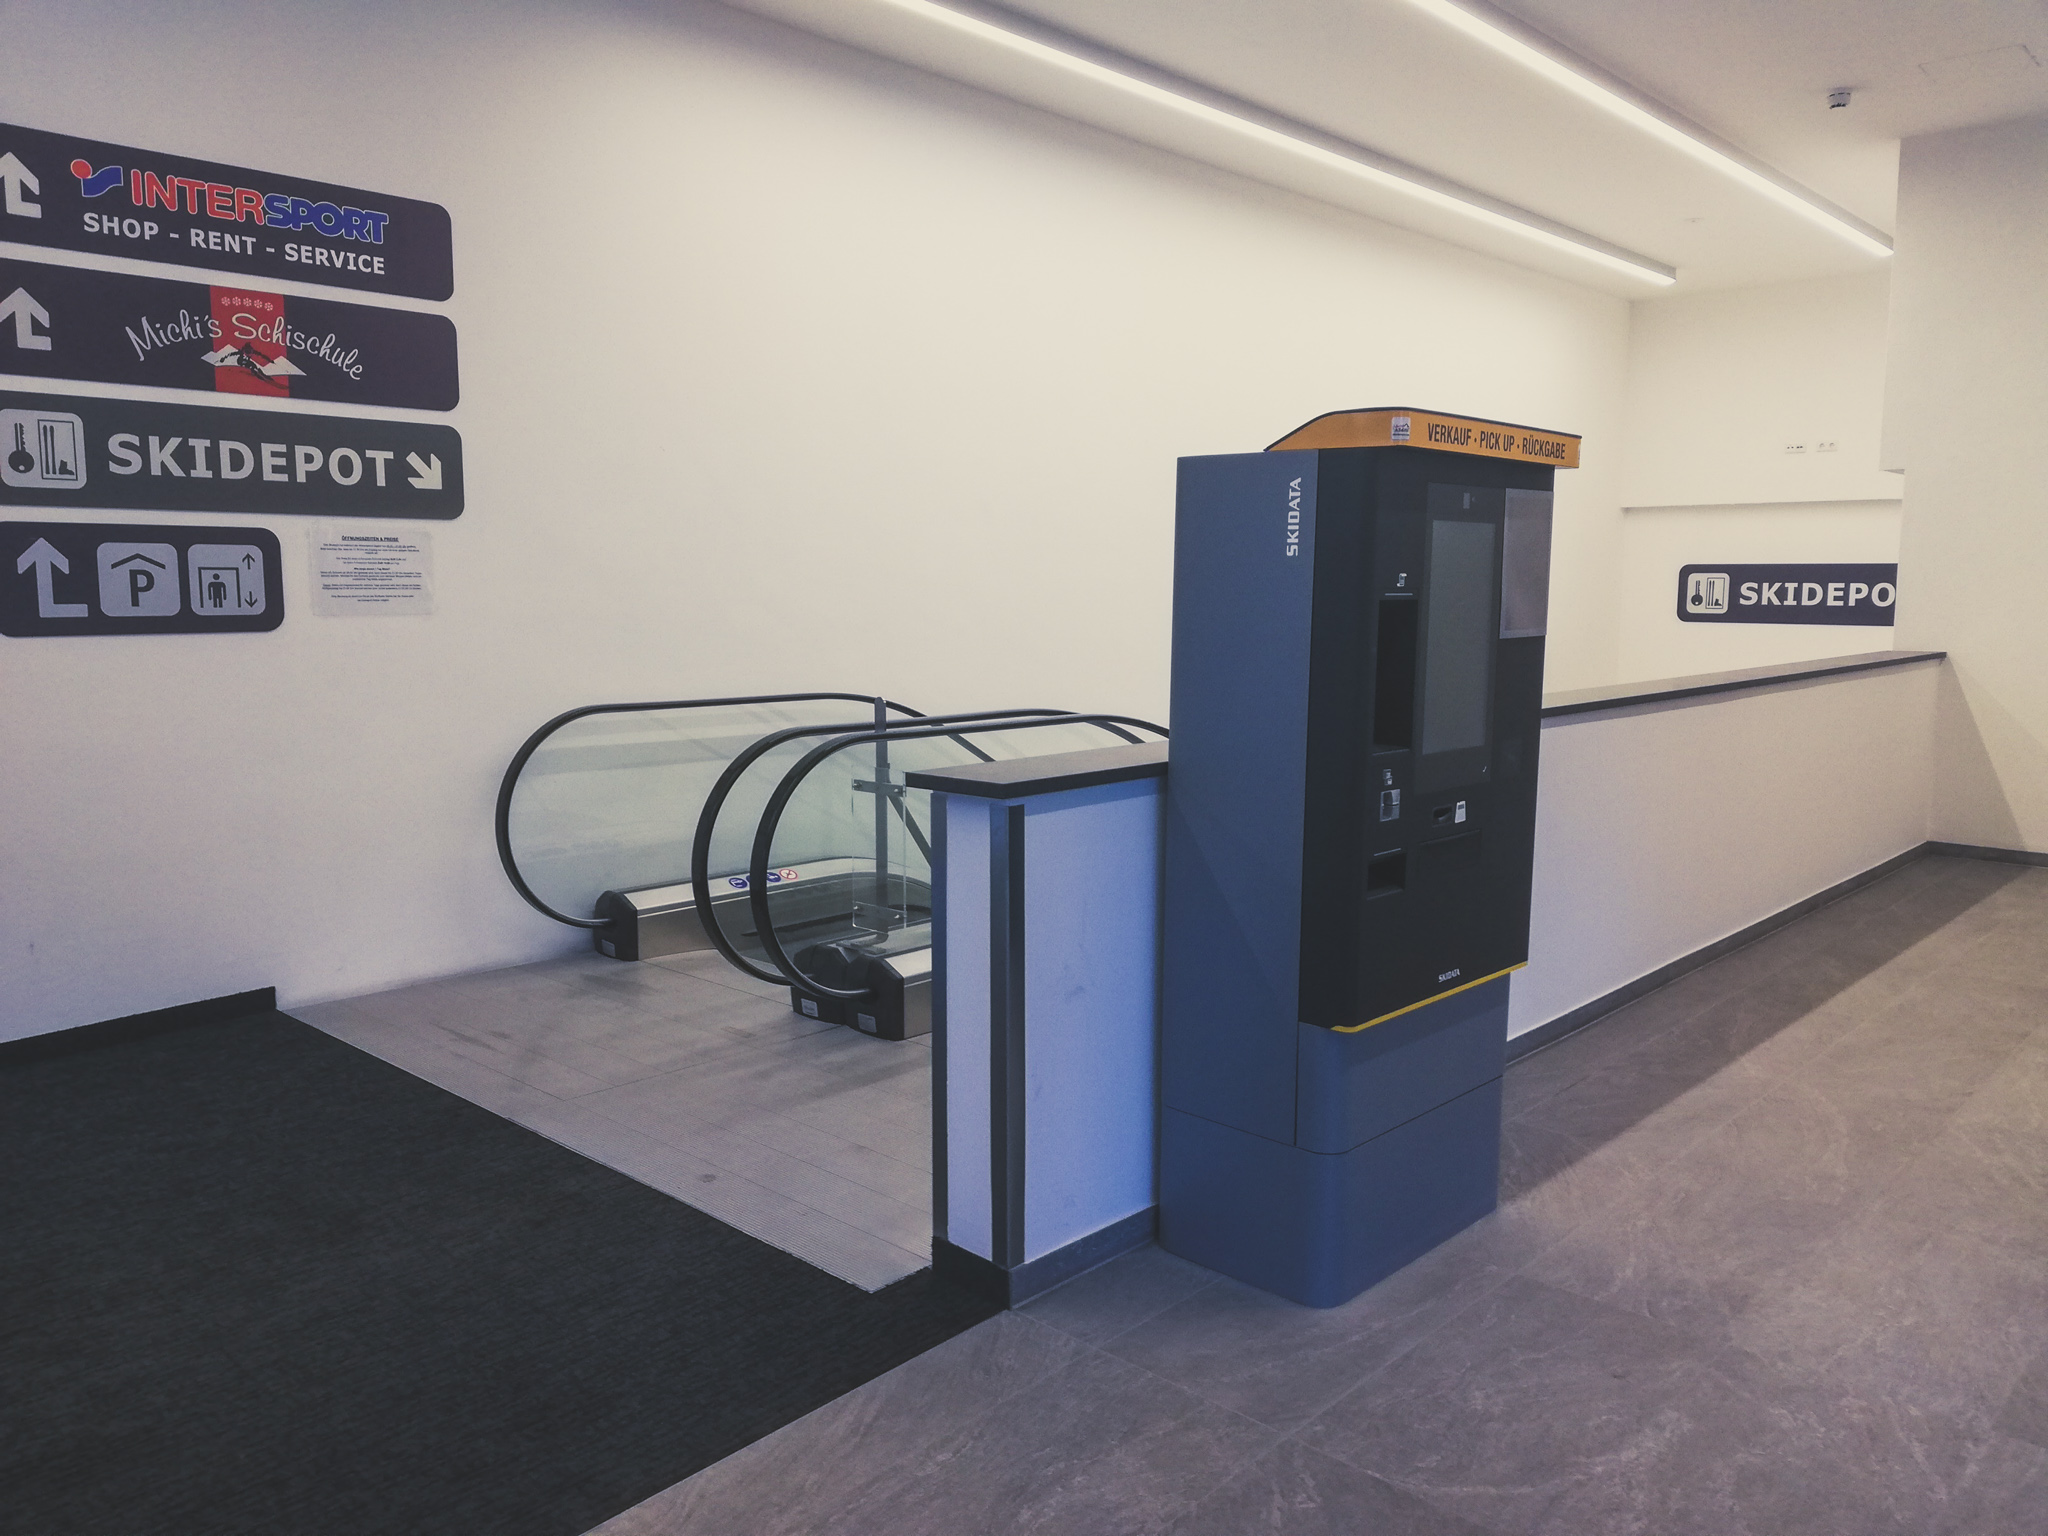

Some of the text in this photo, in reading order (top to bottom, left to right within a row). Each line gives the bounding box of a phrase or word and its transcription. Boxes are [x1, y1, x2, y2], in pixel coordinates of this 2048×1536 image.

[131, 169, 389, 244] INTERSPORT
[83, 213, 159, 241] SHOP
[190, 228, 257, 255] RENT
[284, 243, 386, 275] SERVICE
[125, 309, 364, 380] Michi's Schischule
[107, 432, 394, 487] SKIDEPOT
[1427, 422, 1472, 446] VERKAUF
[1480, 430, 1501, 450] PICK
[1503, 434, 1515, 452] UP
[1522, 434, 1566, 459] RÜCKGABE
[1286, 477, 1302, 557] SKIDATA
[128, 569, 155, 608] P
[1739, 582, 1896, 608] SKIDEPO
